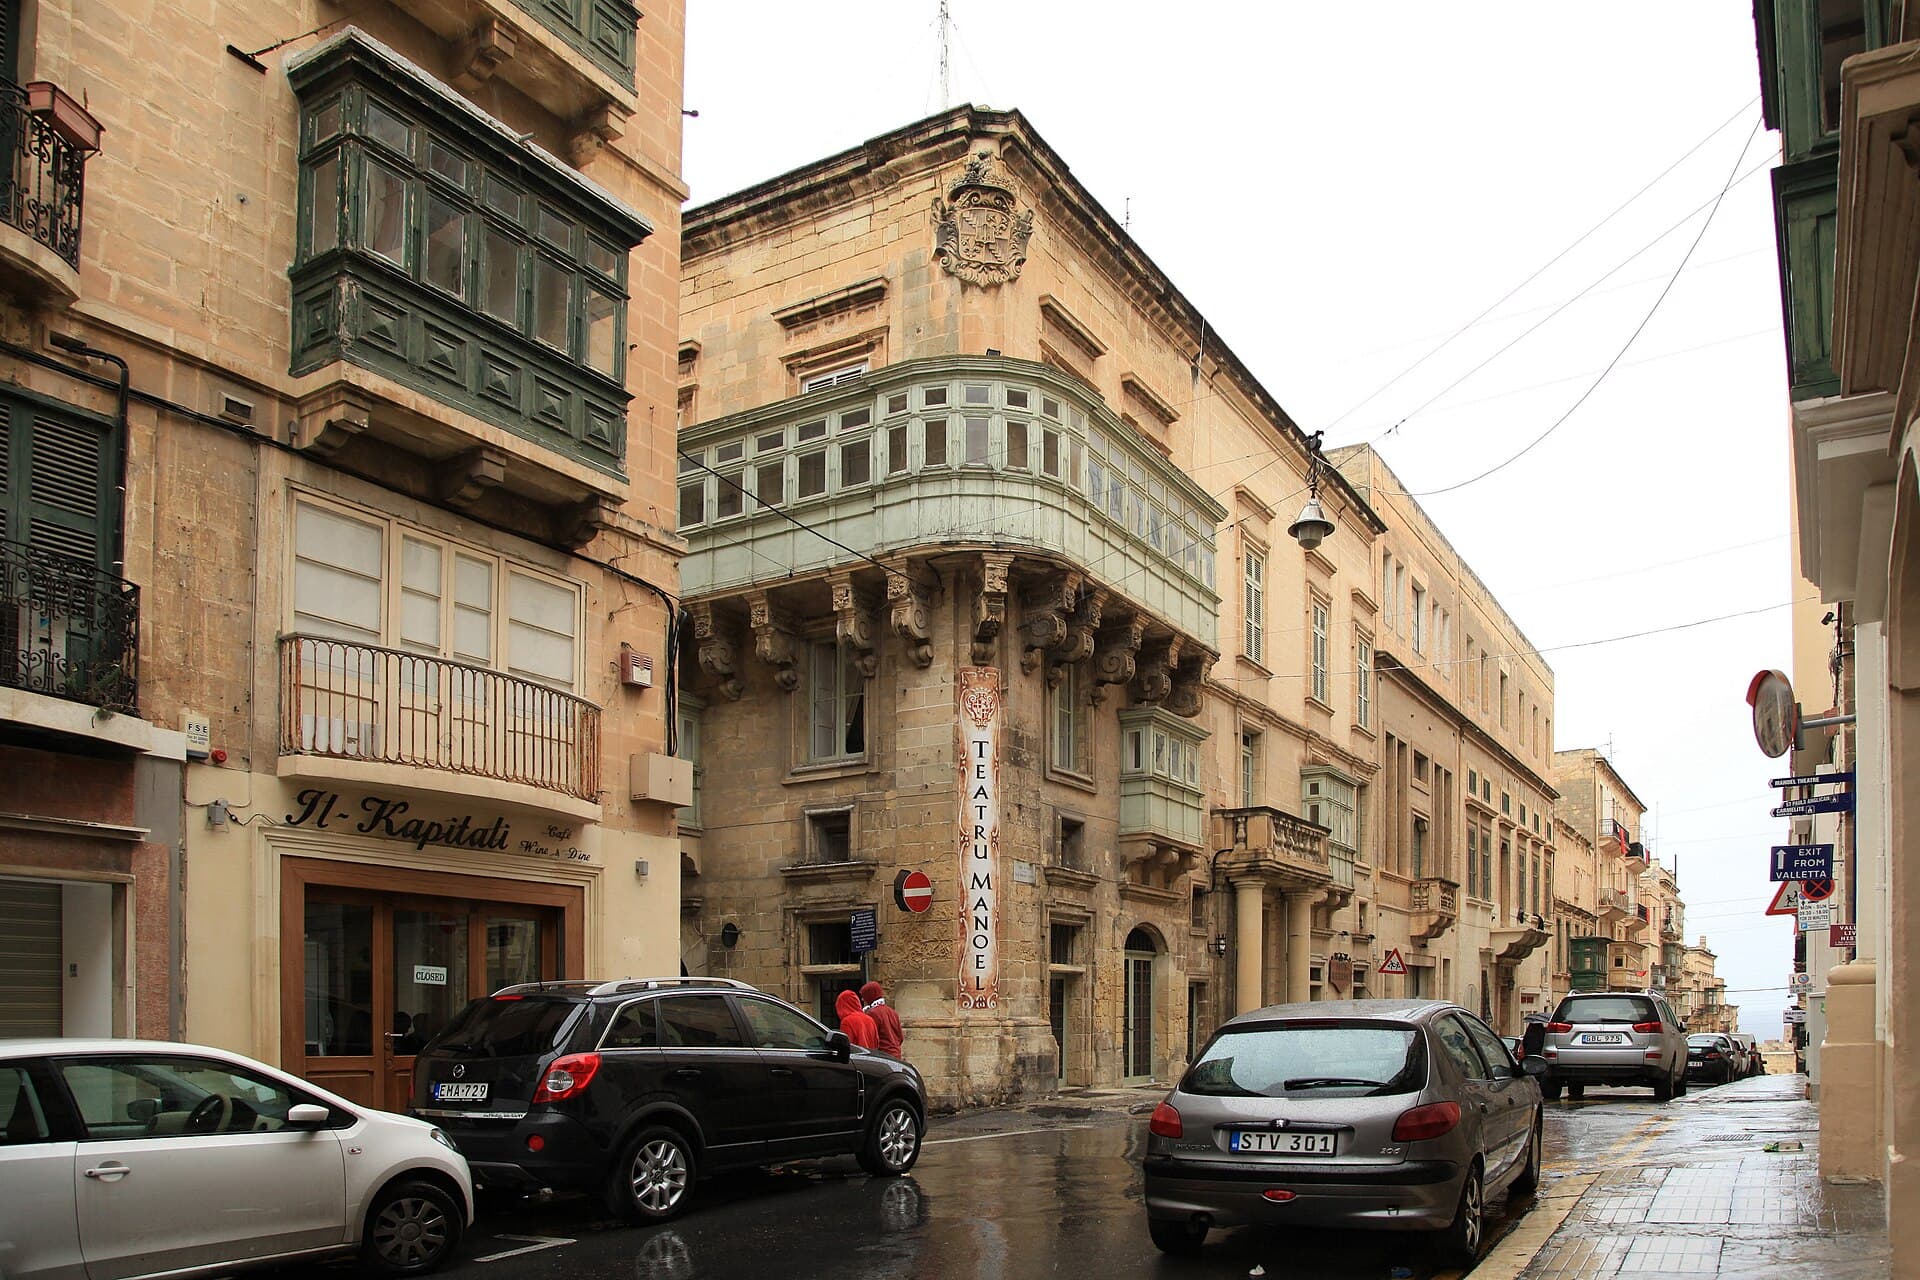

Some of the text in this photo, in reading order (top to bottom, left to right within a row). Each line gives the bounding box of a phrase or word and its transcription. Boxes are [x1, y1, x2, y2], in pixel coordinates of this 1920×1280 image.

[1797, 776, 1820, 784] THEATRE
[519, 840, 549, 855] Wine
[565, 847, 592, 861] Dine
[1798, 848, 1822, 856] EXIT
[969, 740, 993, 992] TEATRU MANOEL
[1793, 858, 1825, 868] FROM
[1776, 870, 1827, 879] VALLETTA
[416, 971, 445, 982] CLOSED
[1240, 1133, 1331, 1152] STV 301
